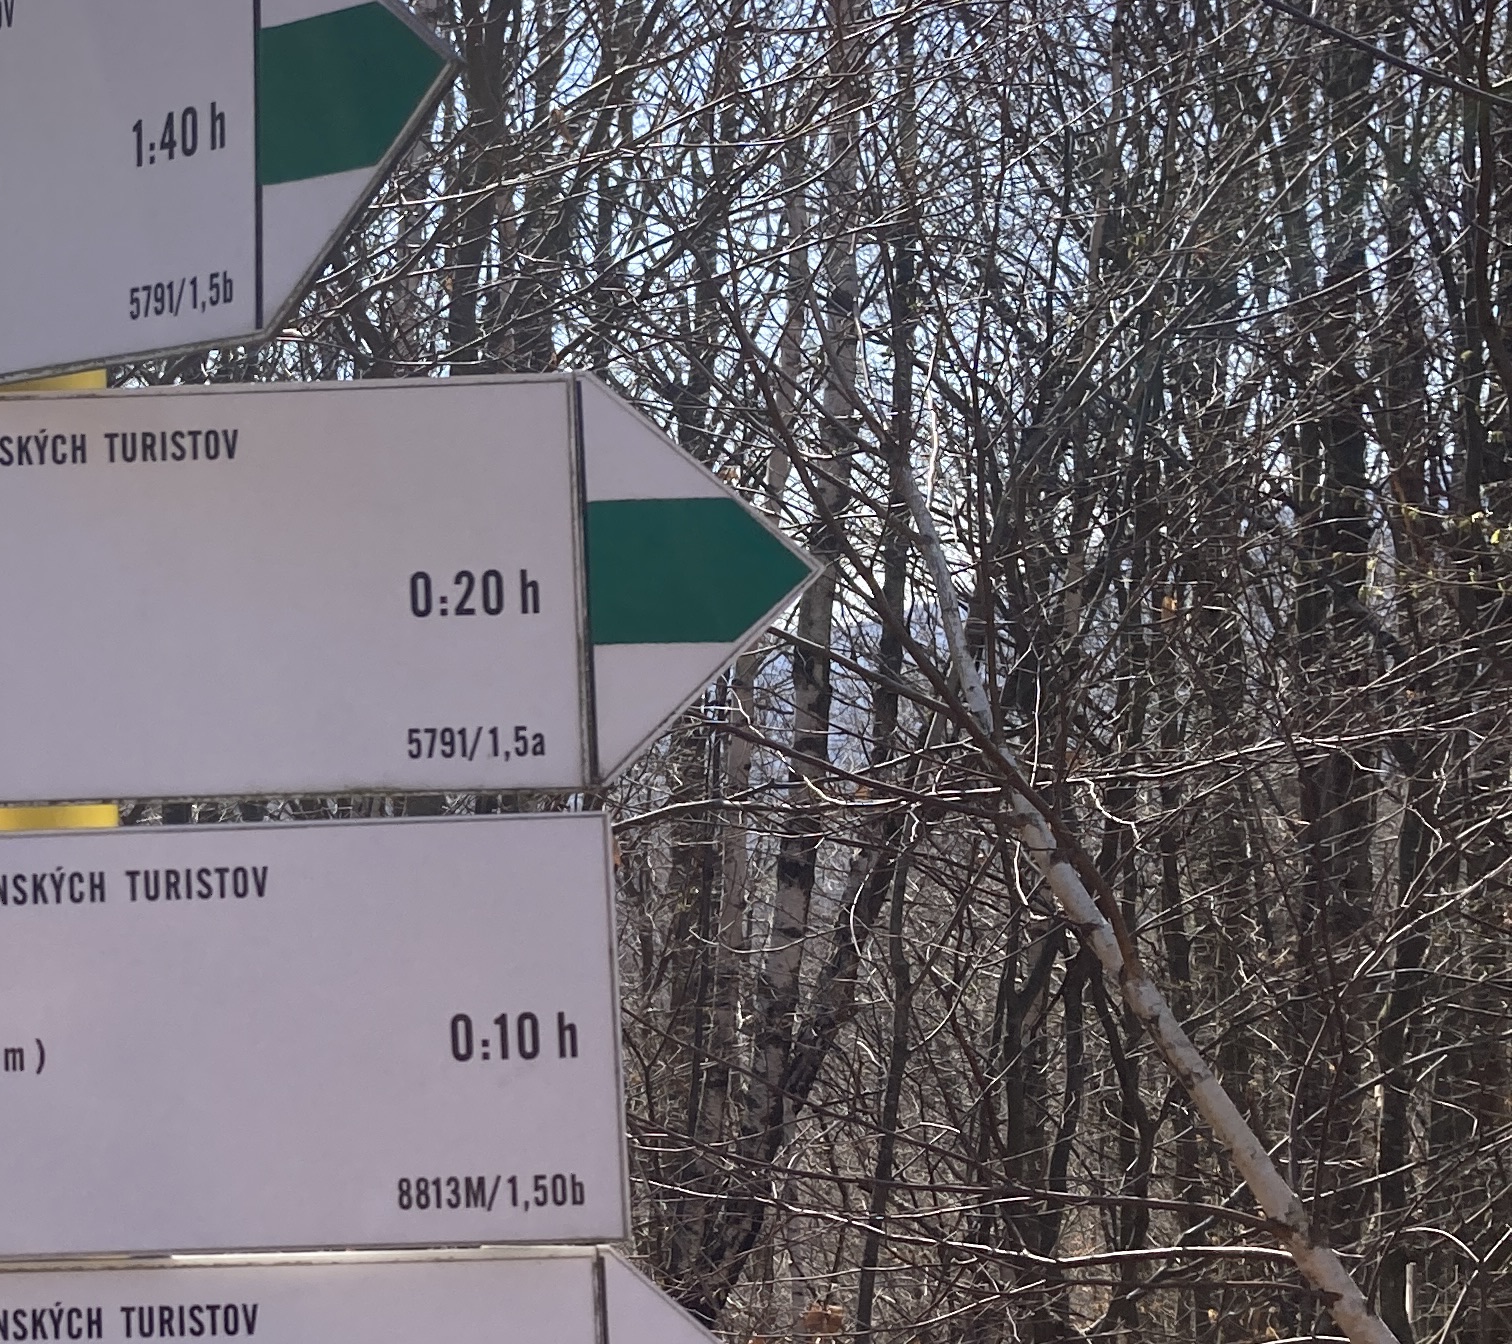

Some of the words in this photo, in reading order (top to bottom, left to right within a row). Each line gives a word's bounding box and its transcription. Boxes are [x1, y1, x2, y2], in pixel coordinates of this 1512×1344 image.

[131, 105, 199, 168] 1:40
[209, 101, 226, 151] h
[129, 270, 234, 321] 5791/1,5b
[103, 428, 239, 464] TURISTOV
[409, 568, 505, 619] 0:20
[519, 568, 541, 615] h
[407, 725, 546, 763] 5791/1,5a
[124, 865, 269, 903] TURISTOV
[449, 1011, 541, 1063] 0:10
[556, 1010, 579, 1060] h
[397, 1172, 586, 1213] 8813M/1,50b
[119, 1302, 259, 1339] TURISTOV
